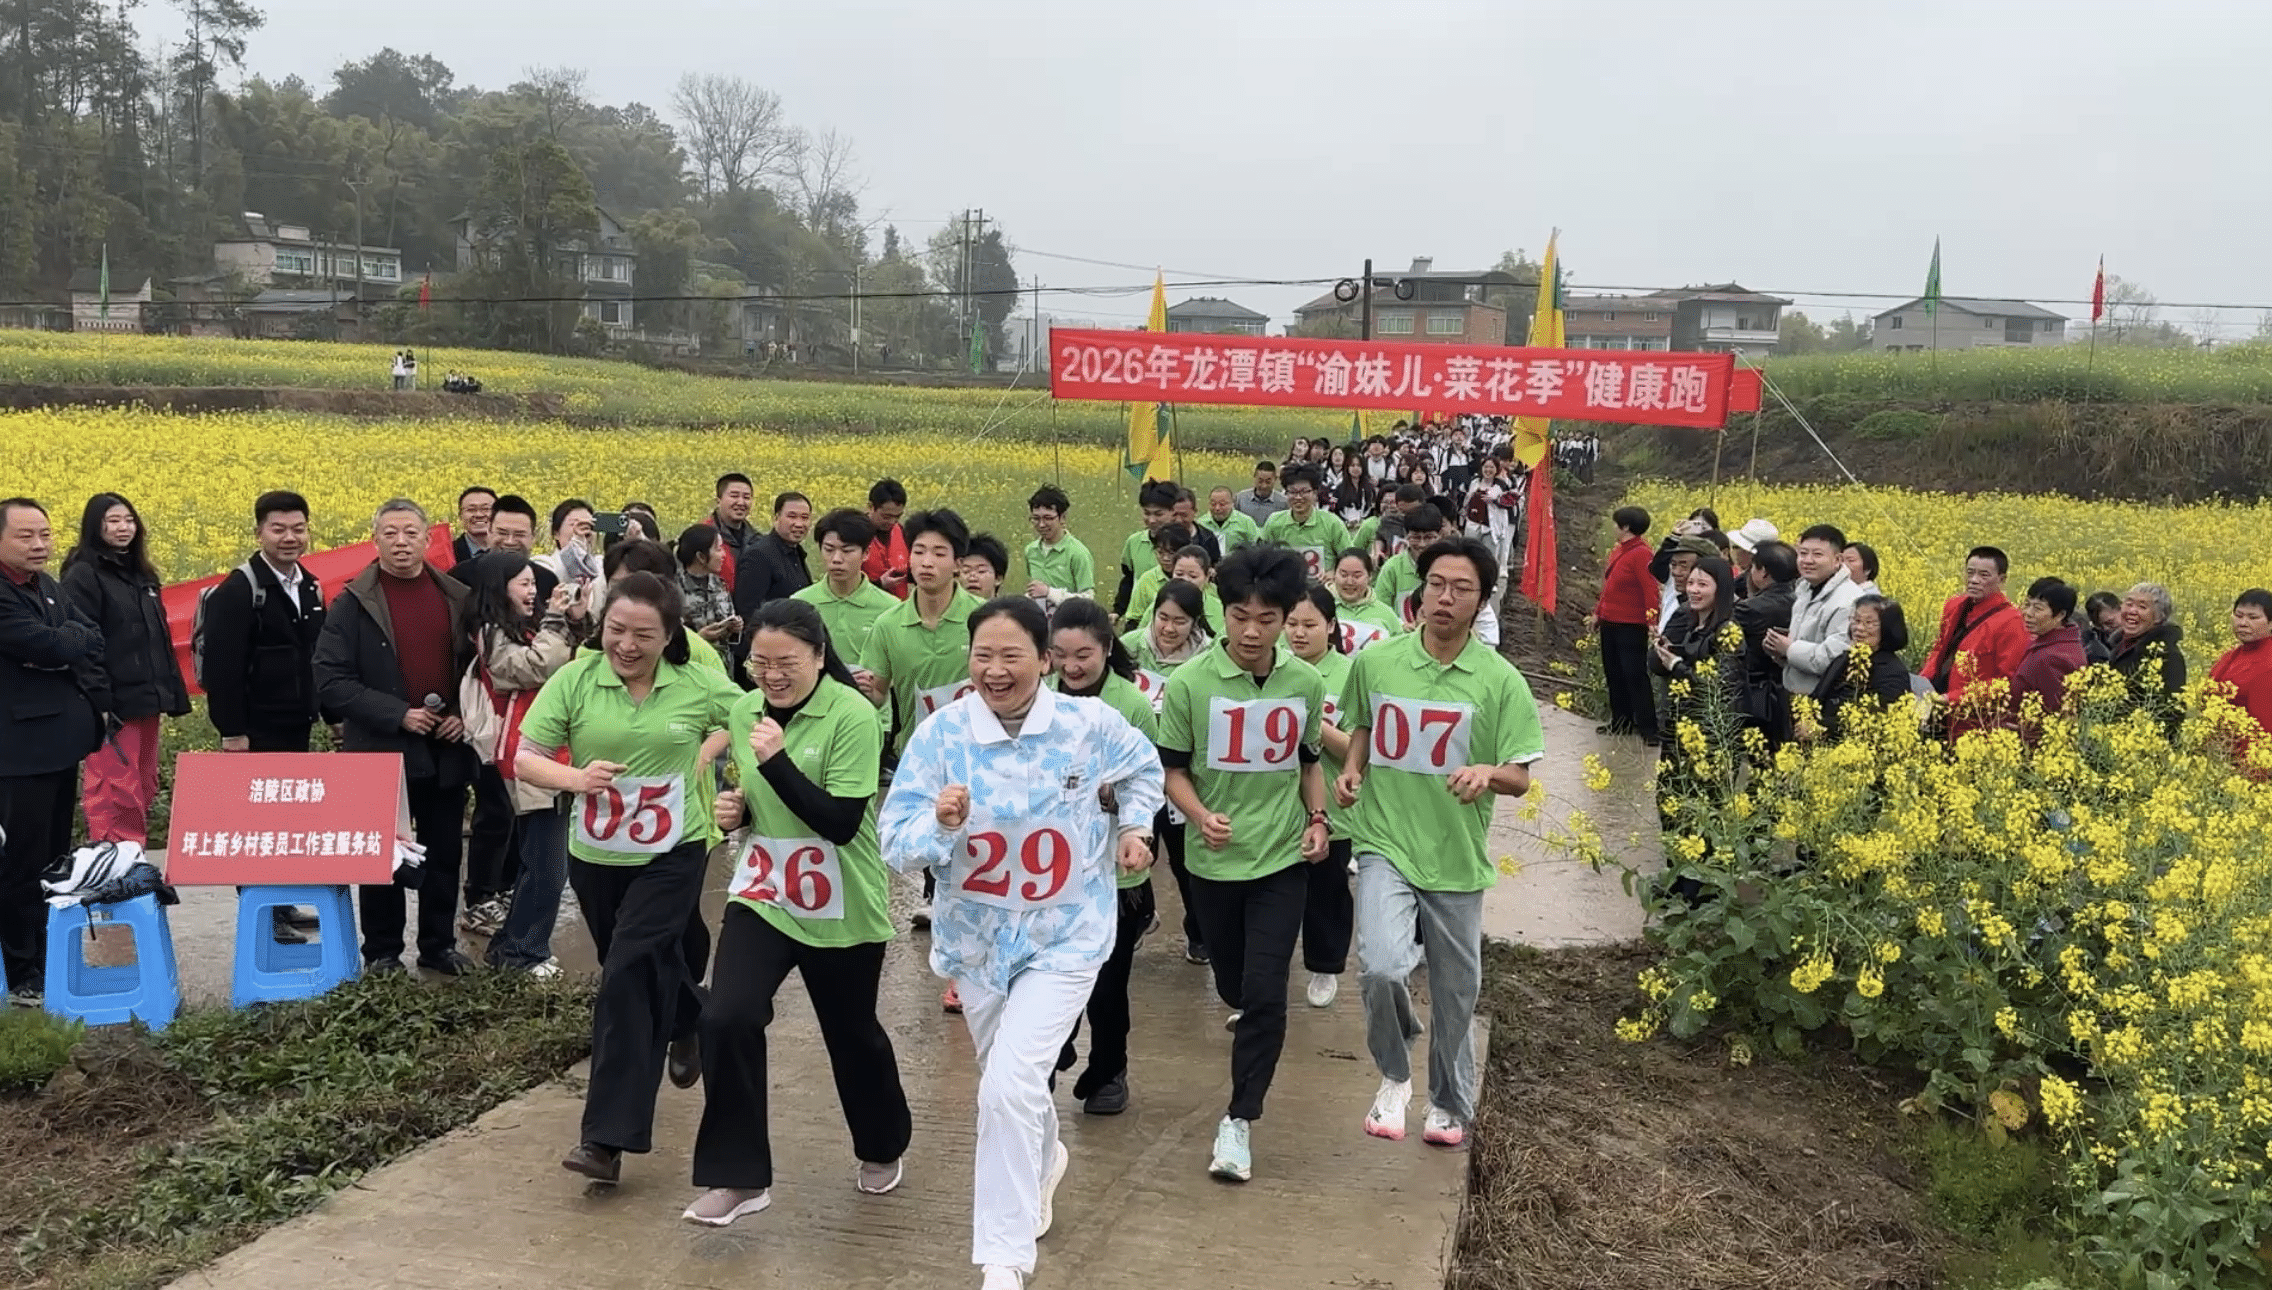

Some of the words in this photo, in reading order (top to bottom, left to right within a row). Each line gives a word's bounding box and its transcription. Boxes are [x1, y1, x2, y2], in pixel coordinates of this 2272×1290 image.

[1217, 706, 1299, 764] 19
[1375, 702, 1462, 768] 07
[249, 778, 326, 803] 涪陵区政协
[584, 782, 672, 845] 05
[181, 831, 383, 857] 坪上新乡村委员工作室服务站
[962, 828, 1071, 901] 29
[737, 844, 832, 911] 26
